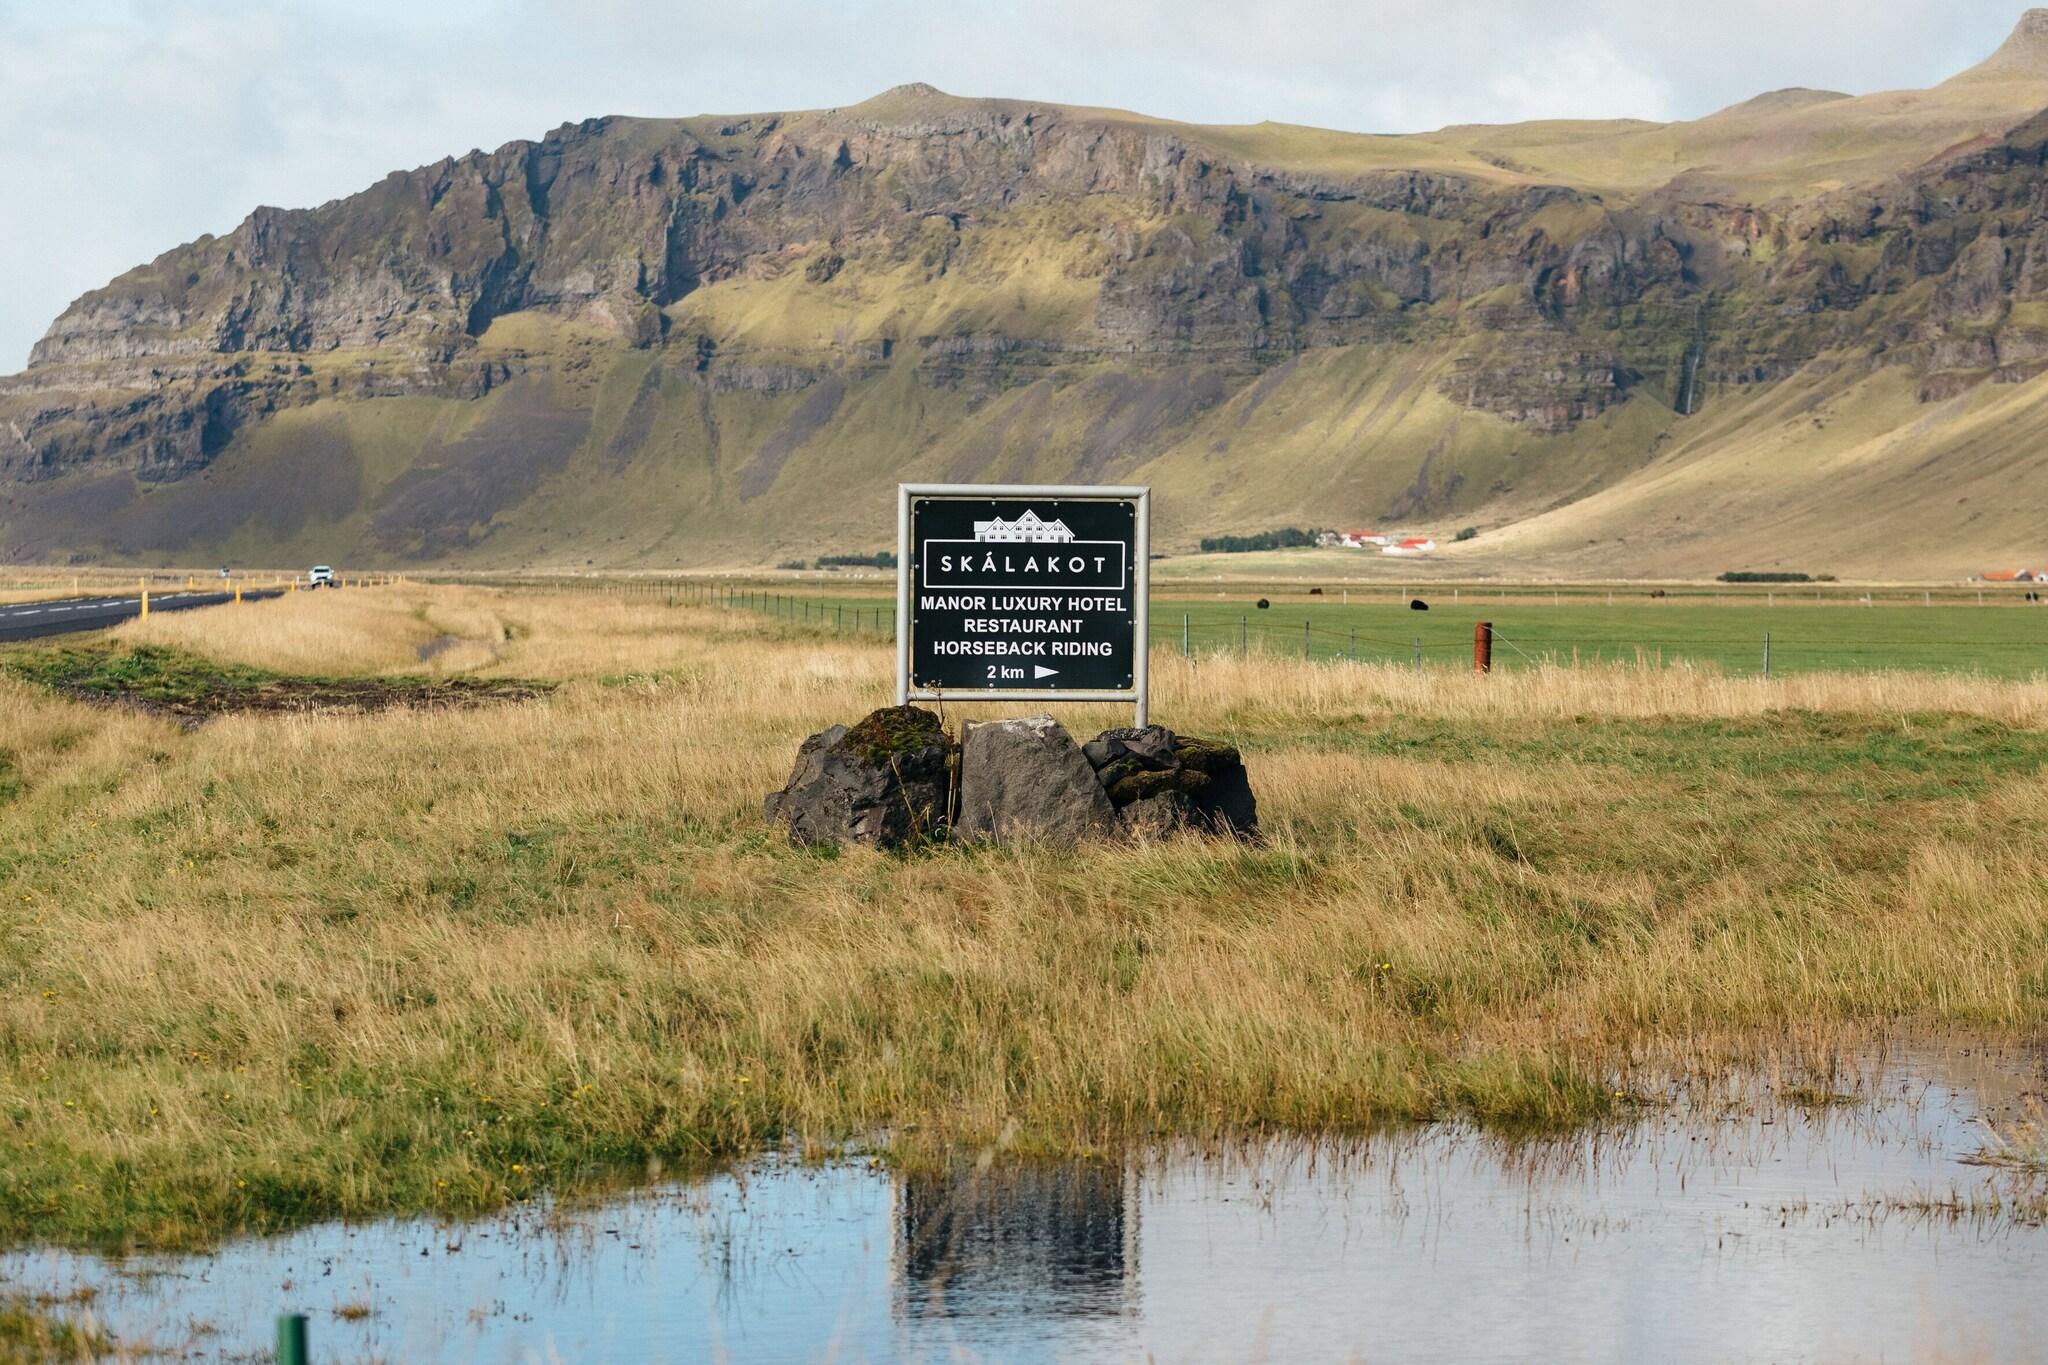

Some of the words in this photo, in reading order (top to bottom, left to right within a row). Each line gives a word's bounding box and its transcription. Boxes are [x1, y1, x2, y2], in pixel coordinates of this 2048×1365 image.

[941, 551, 1106, 573] SKÁLAKOT
[921, 596, 987, 611] MANOR
[992, 596, 1063, 611] LUXURY
[1068, 597, 1127, 612] HOTEL
[964, 618, 1084, 634] RESTAURANT
[934, 640, 1046, 656] HORSEBACK
[1051, 641, 1113, 657] RIDING
[986, 664, 997, 679] 2
[1001, 664, 1025, 679] km
